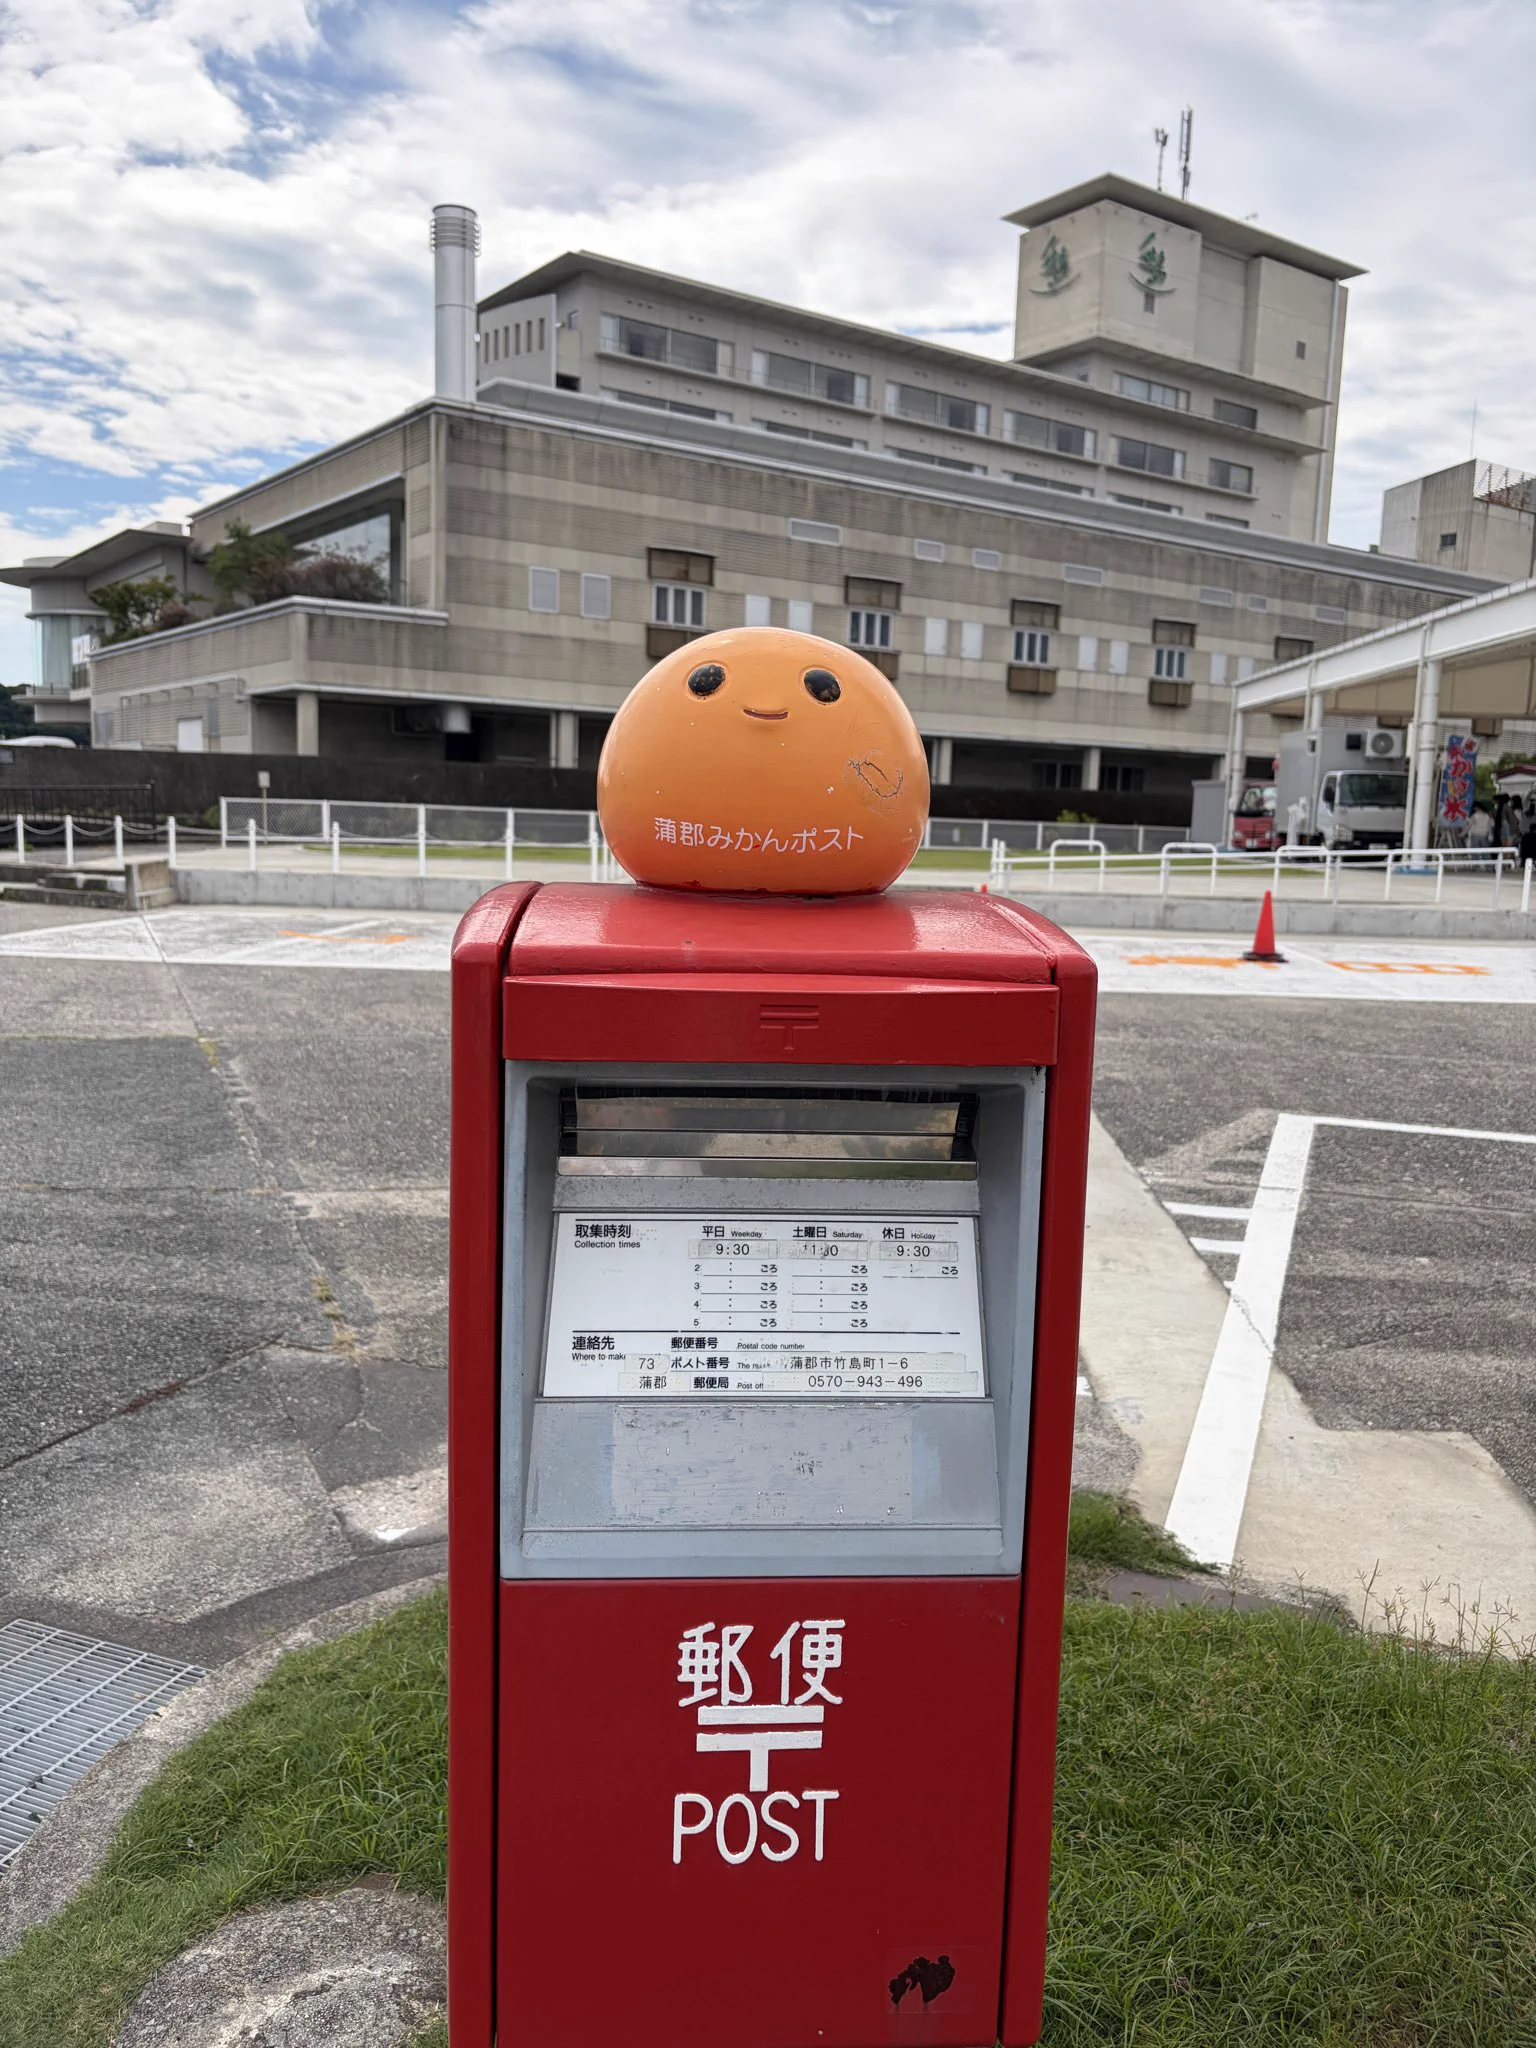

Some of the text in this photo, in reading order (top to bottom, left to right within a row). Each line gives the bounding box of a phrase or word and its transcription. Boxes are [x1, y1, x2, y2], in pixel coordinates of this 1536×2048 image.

[654, 817, 863, 853] 蒲郡みかんポスト
[575, 1224, 631, 1238] 取集時刻
[703, 1226, 762, 1238] 平日 Weekday
[793, 1226, 863, 1240] 土曜日 Saturday
[882, 1228, 936, 1240] 休日 Holiday
[575, 1240, 640, 1248] Collection times
[716, 1244, 749, 1255] 9:30
[897, 1245, 930, 1257] 9:30
[572, 1336, 614, 1350] 連絡先
[671, 1337, 718, 1349] 郵便番号
[572, 1352, 595, 1360] Where
[598, 1352, 606, 1360] to
[639, 1358, 654, 1369] 73
[671, 1357, 729, 1369] ポスト番号
[737, 1361, 750, 1369] The
[640, 1376, 666, 1389] 蒲郡
[694, 1377, 729, 1389] 郵便局
[809, 1376, 922, 1387] 0570-943-496
[677, 1619, 845, 1707] 郵便
[673, 1790, 840, 1864] POST
